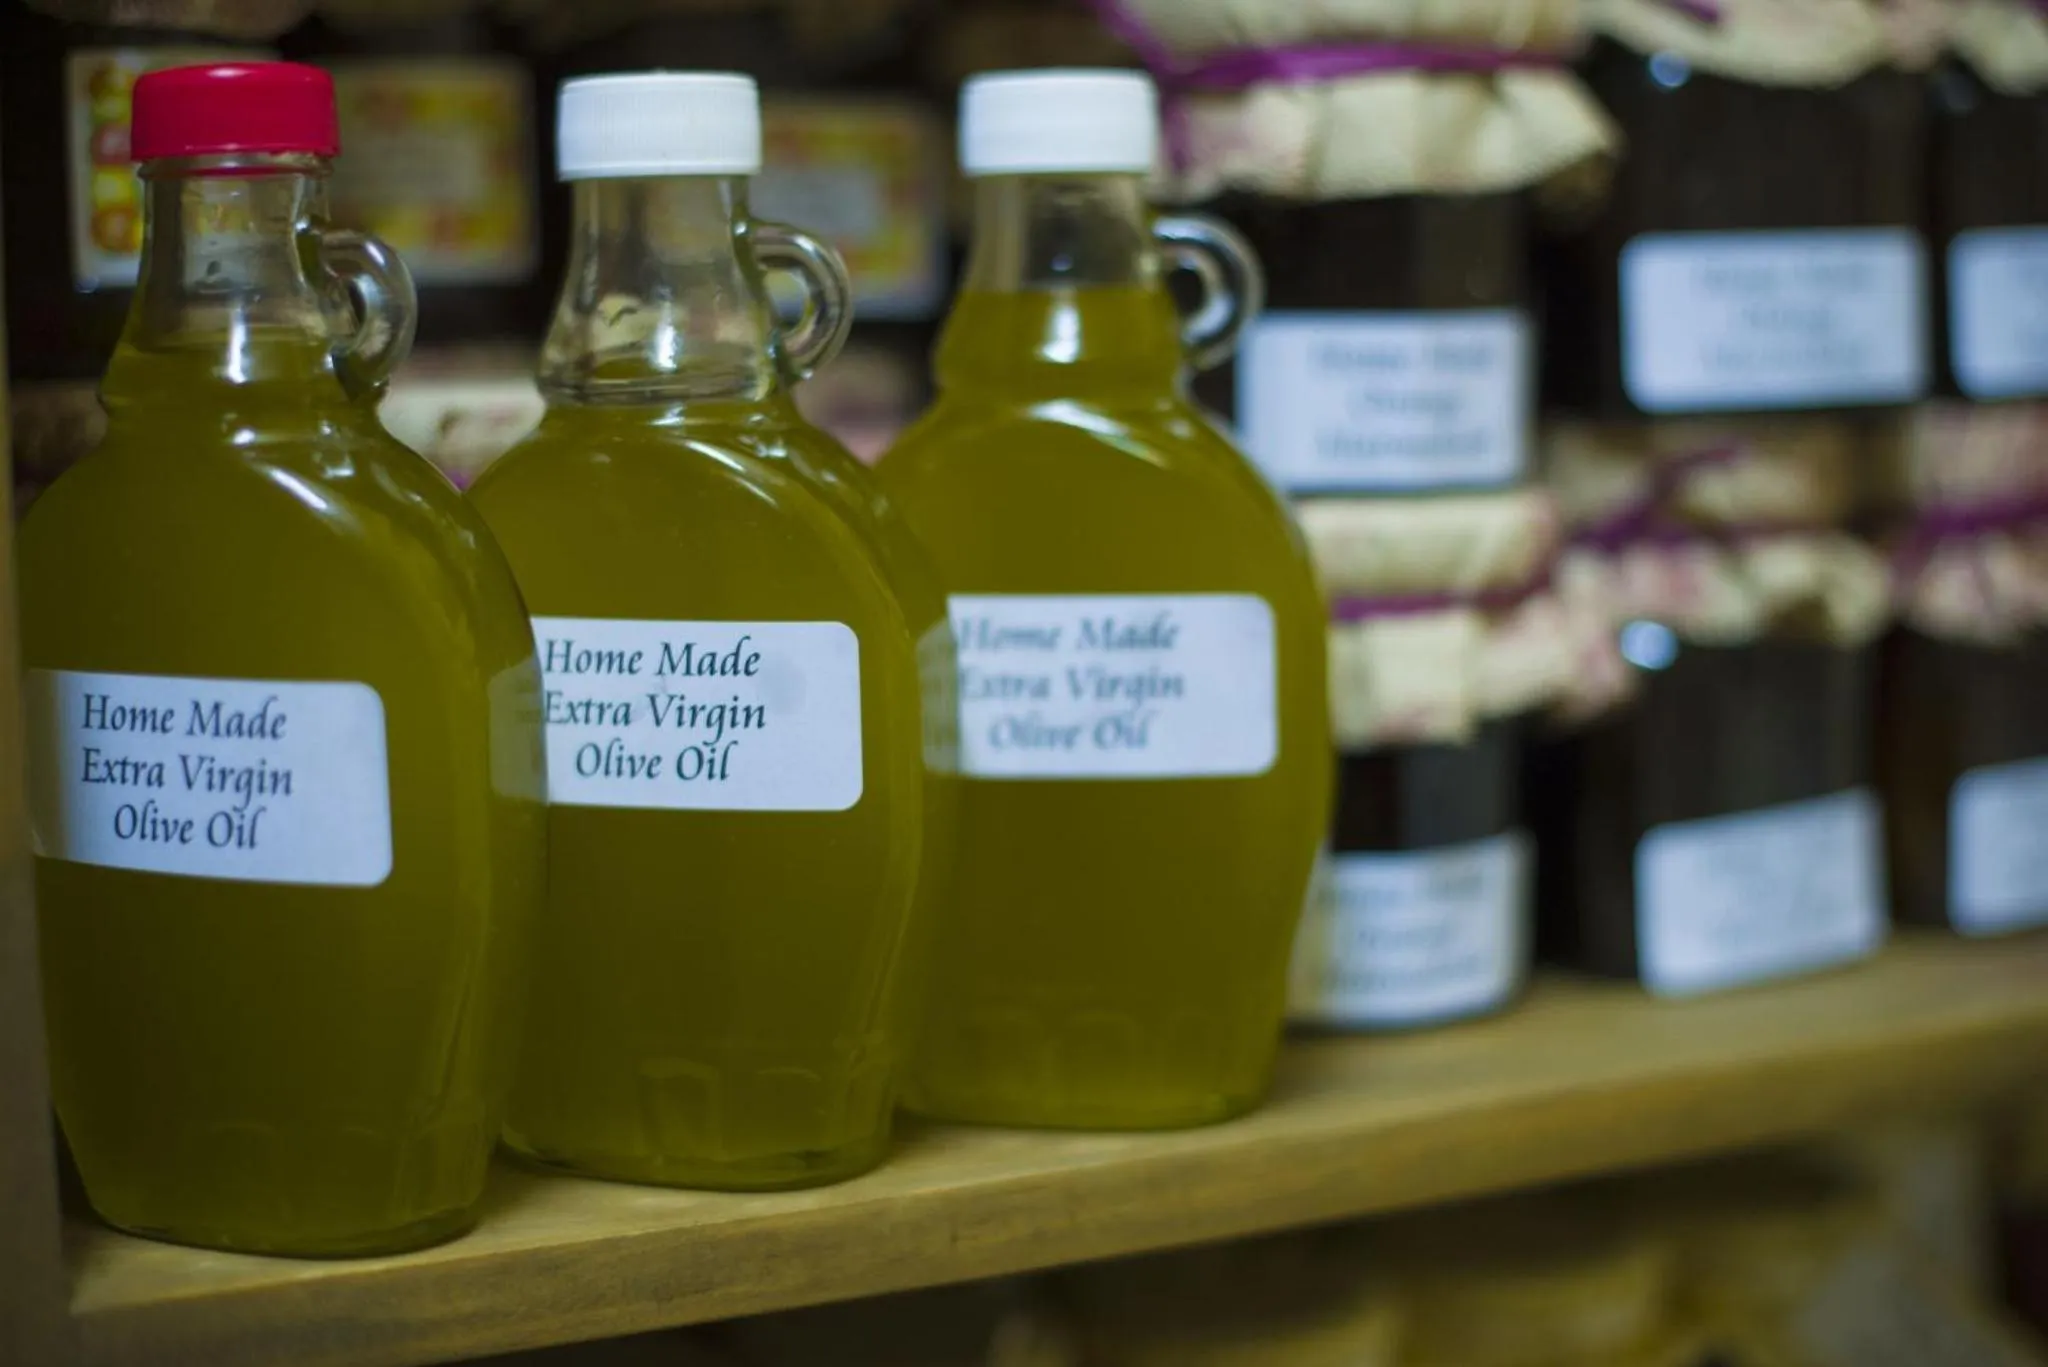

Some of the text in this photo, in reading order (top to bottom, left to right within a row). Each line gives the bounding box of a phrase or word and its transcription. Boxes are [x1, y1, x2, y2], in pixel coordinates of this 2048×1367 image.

[959, 611, 1179, 650] Home Made
[545, 635, 761, 677] Home Made
[958, 666, 1184, 707] Extra Virgin
[81, 693, 287, 740] Home Made
[544, 691, 766, 746] Extra Virgin
[989, 710, 1158, 750] Olive Oil
[81, 747, 292, 812] Extra Virgin
[575, 737, 739, 781] Olive Oil
[114, 799, 268, 849] Olive Oil
